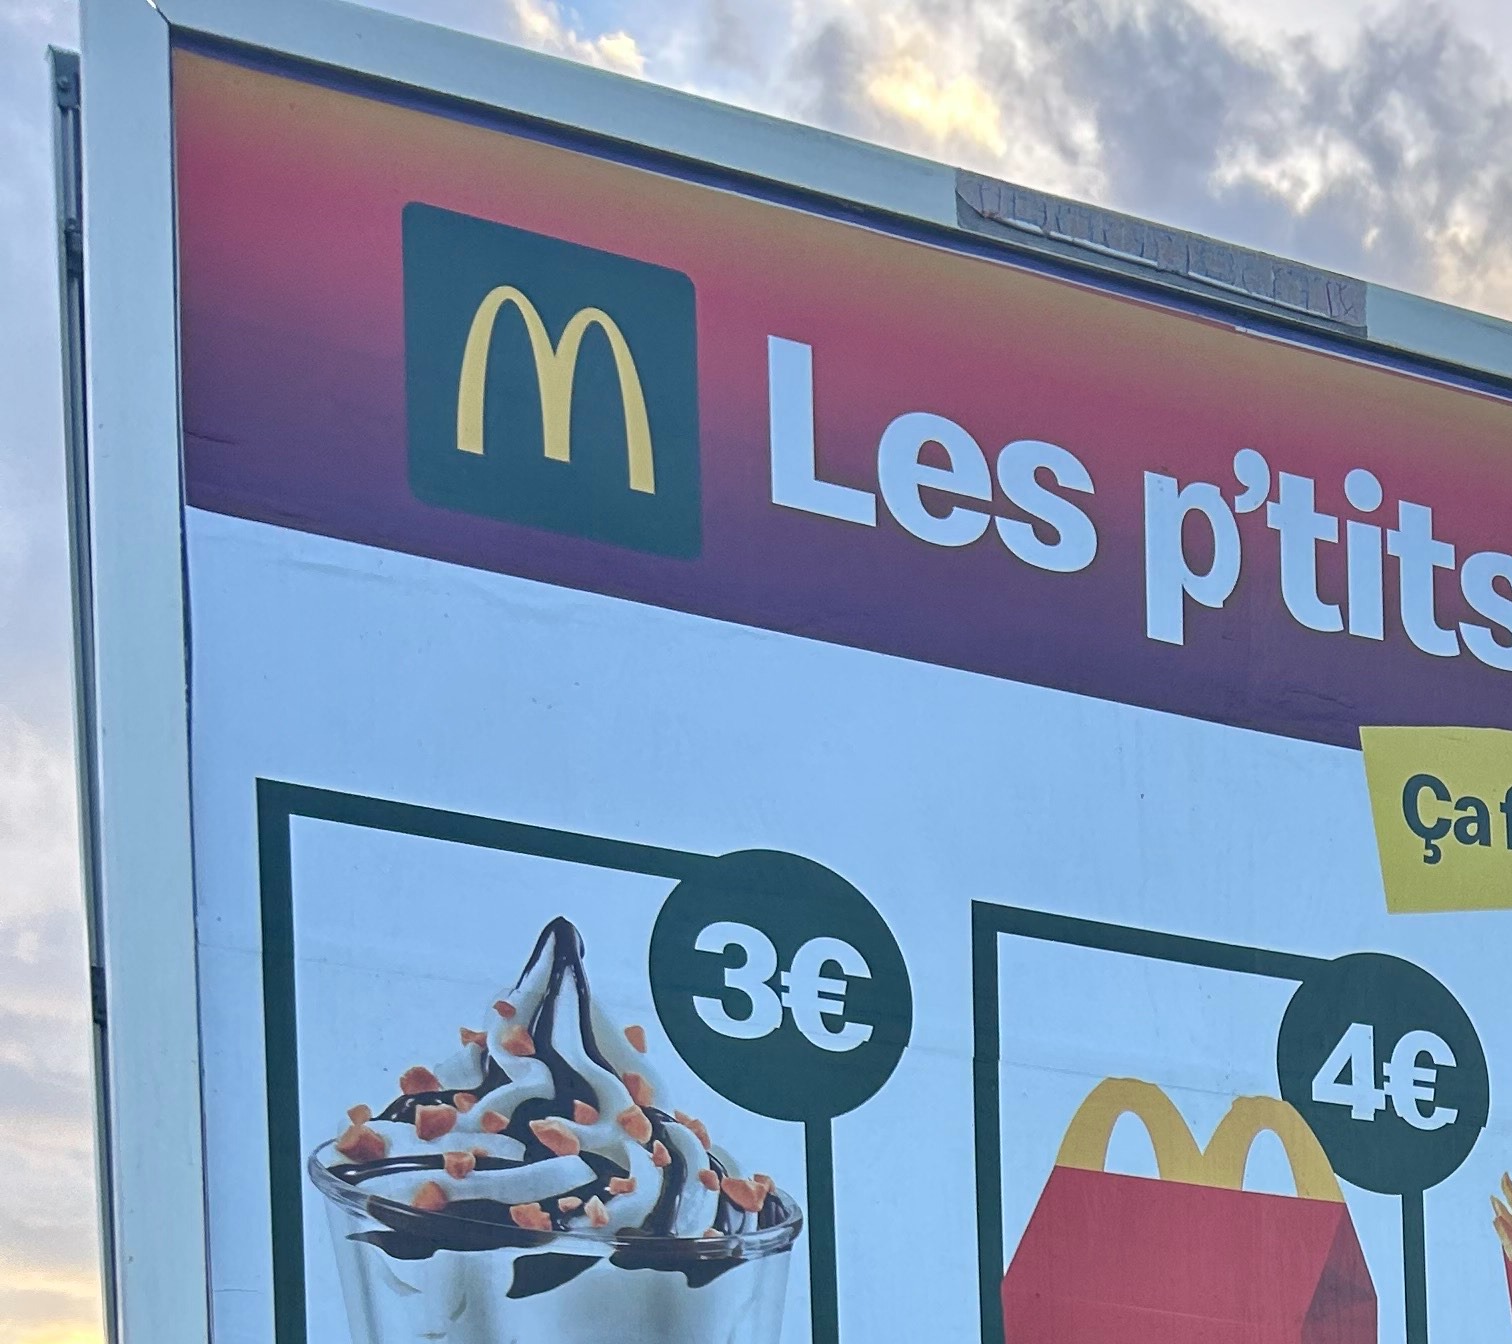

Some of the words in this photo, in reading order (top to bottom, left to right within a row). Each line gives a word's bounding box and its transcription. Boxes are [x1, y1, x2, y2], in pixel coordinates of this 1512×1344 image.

[767, 335, 1098, 572] Les
[1403, 774, 1491, 864] Ça
[693, 922, 873, 1051] 3€
[1312, 1023, 1458, 1131] 4€
